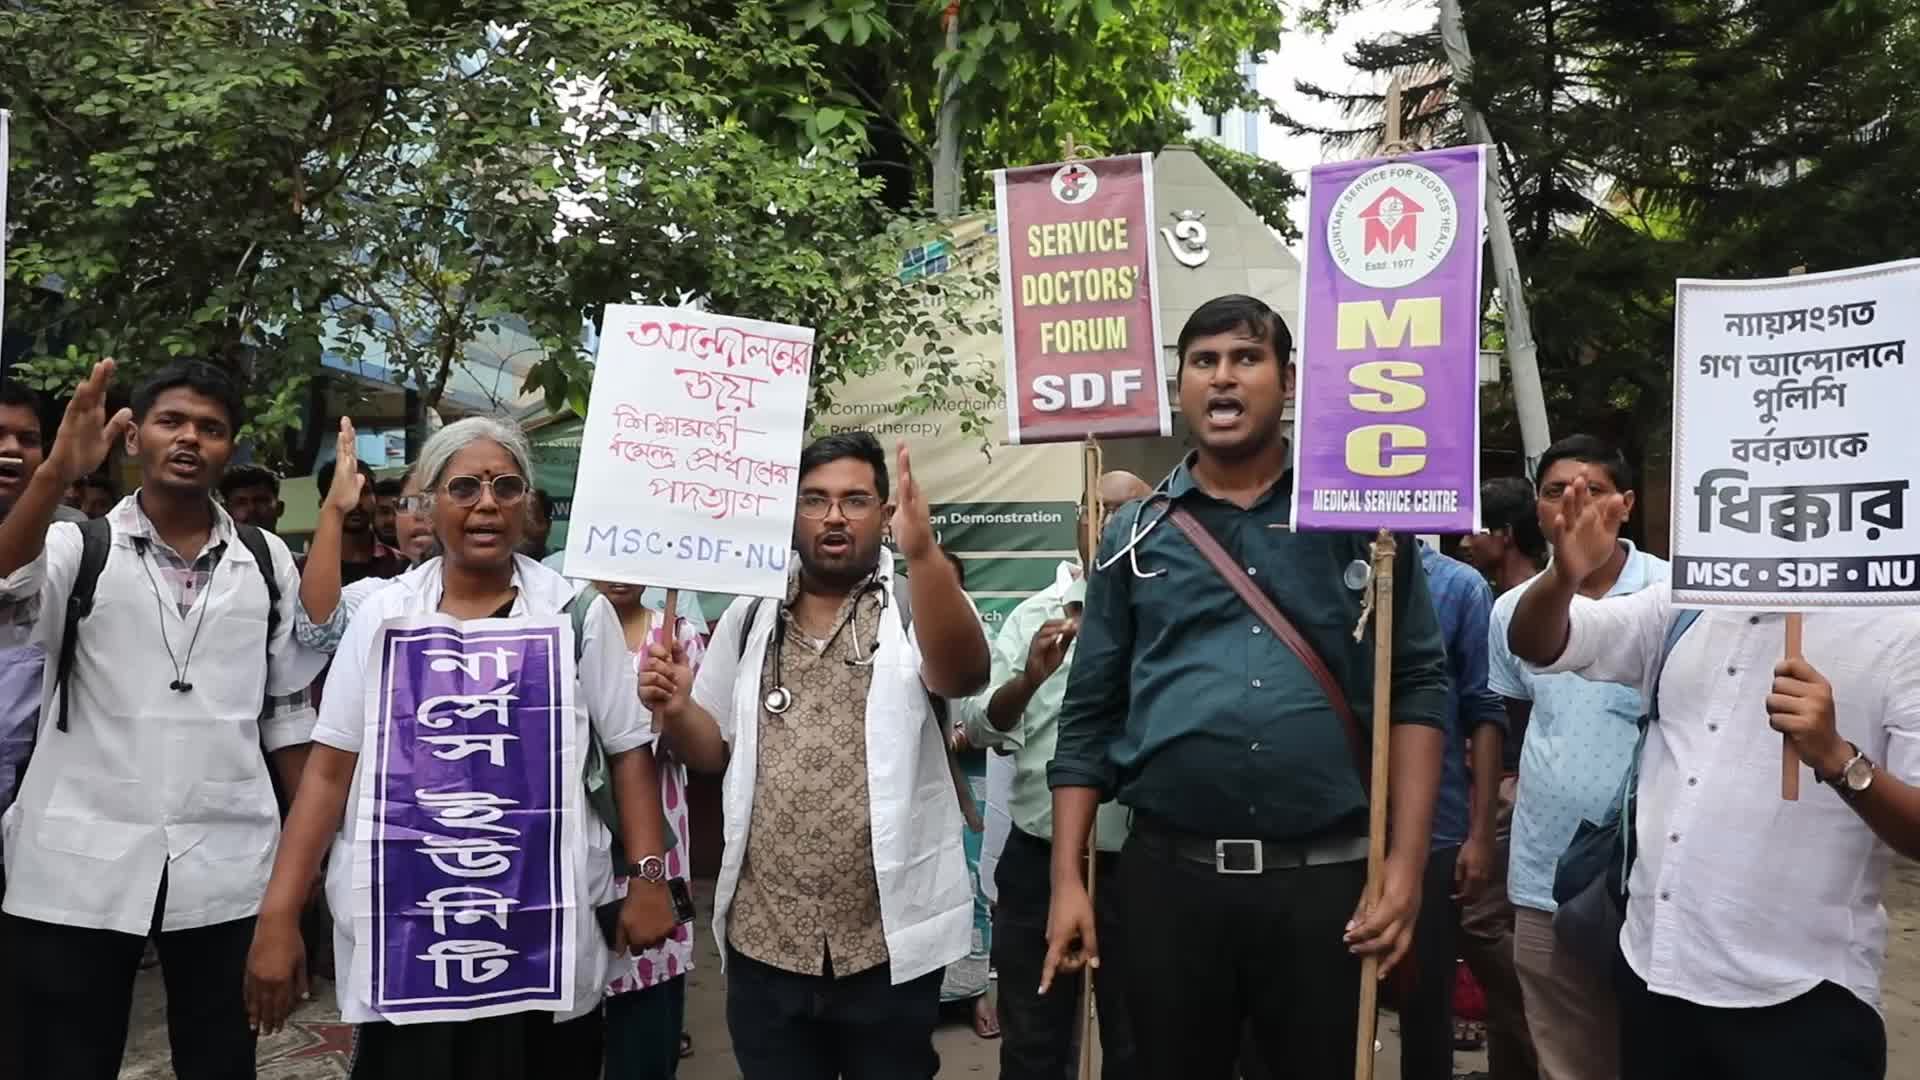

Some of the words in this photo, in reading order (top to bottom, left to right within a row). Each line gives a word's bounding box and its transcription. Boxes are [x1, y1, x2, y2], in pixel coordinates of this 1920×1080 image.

[1332, 203, 1351, 265] VOLUNTARY
[1344, 170, 1386, 202] SERVICE
[1390, 168, 1414, 178] FOR
[1428, 218, 1451, 261] HEALTH
[1028, 217, 1129, 258] SERVICE
[1392, 258, 1415, 269] 1977
[1022, 265, 1139, 307] DOCTORS'
[1041, 317, 1128, 355] FORUM
[1724, 300, 1876, 341] ন্যায়সংগত
[626, 321, 813, 377] আন্দোলনের
[1699, 353, 1742, 379] গণ
[1747, 339, 1906, 377] আন্দোলনে
[673, 367, 769, 412] জয়
[830, 400, 929, 416] Commu
[1032, 368, 1143, 412] SDF
[1752, 375, 1847, 424] পুলিশি
[1730, 427, 1869, 466] বর্বরতাকে
[951, 511, 1062, 524] Demonstration
[1313, 489, 1362, 512] MEDICAL
[1364, 490, 1411, 513] SERVICE
[1414, 490, 1458, 513] CENTRE
[1693, 467, 1910, 543] ধিক্কার
[1686, 562, 1750, 588] MSC
[1777, 561, 1838, 588] SDF
[1867, 559, 1916, 587] NU
